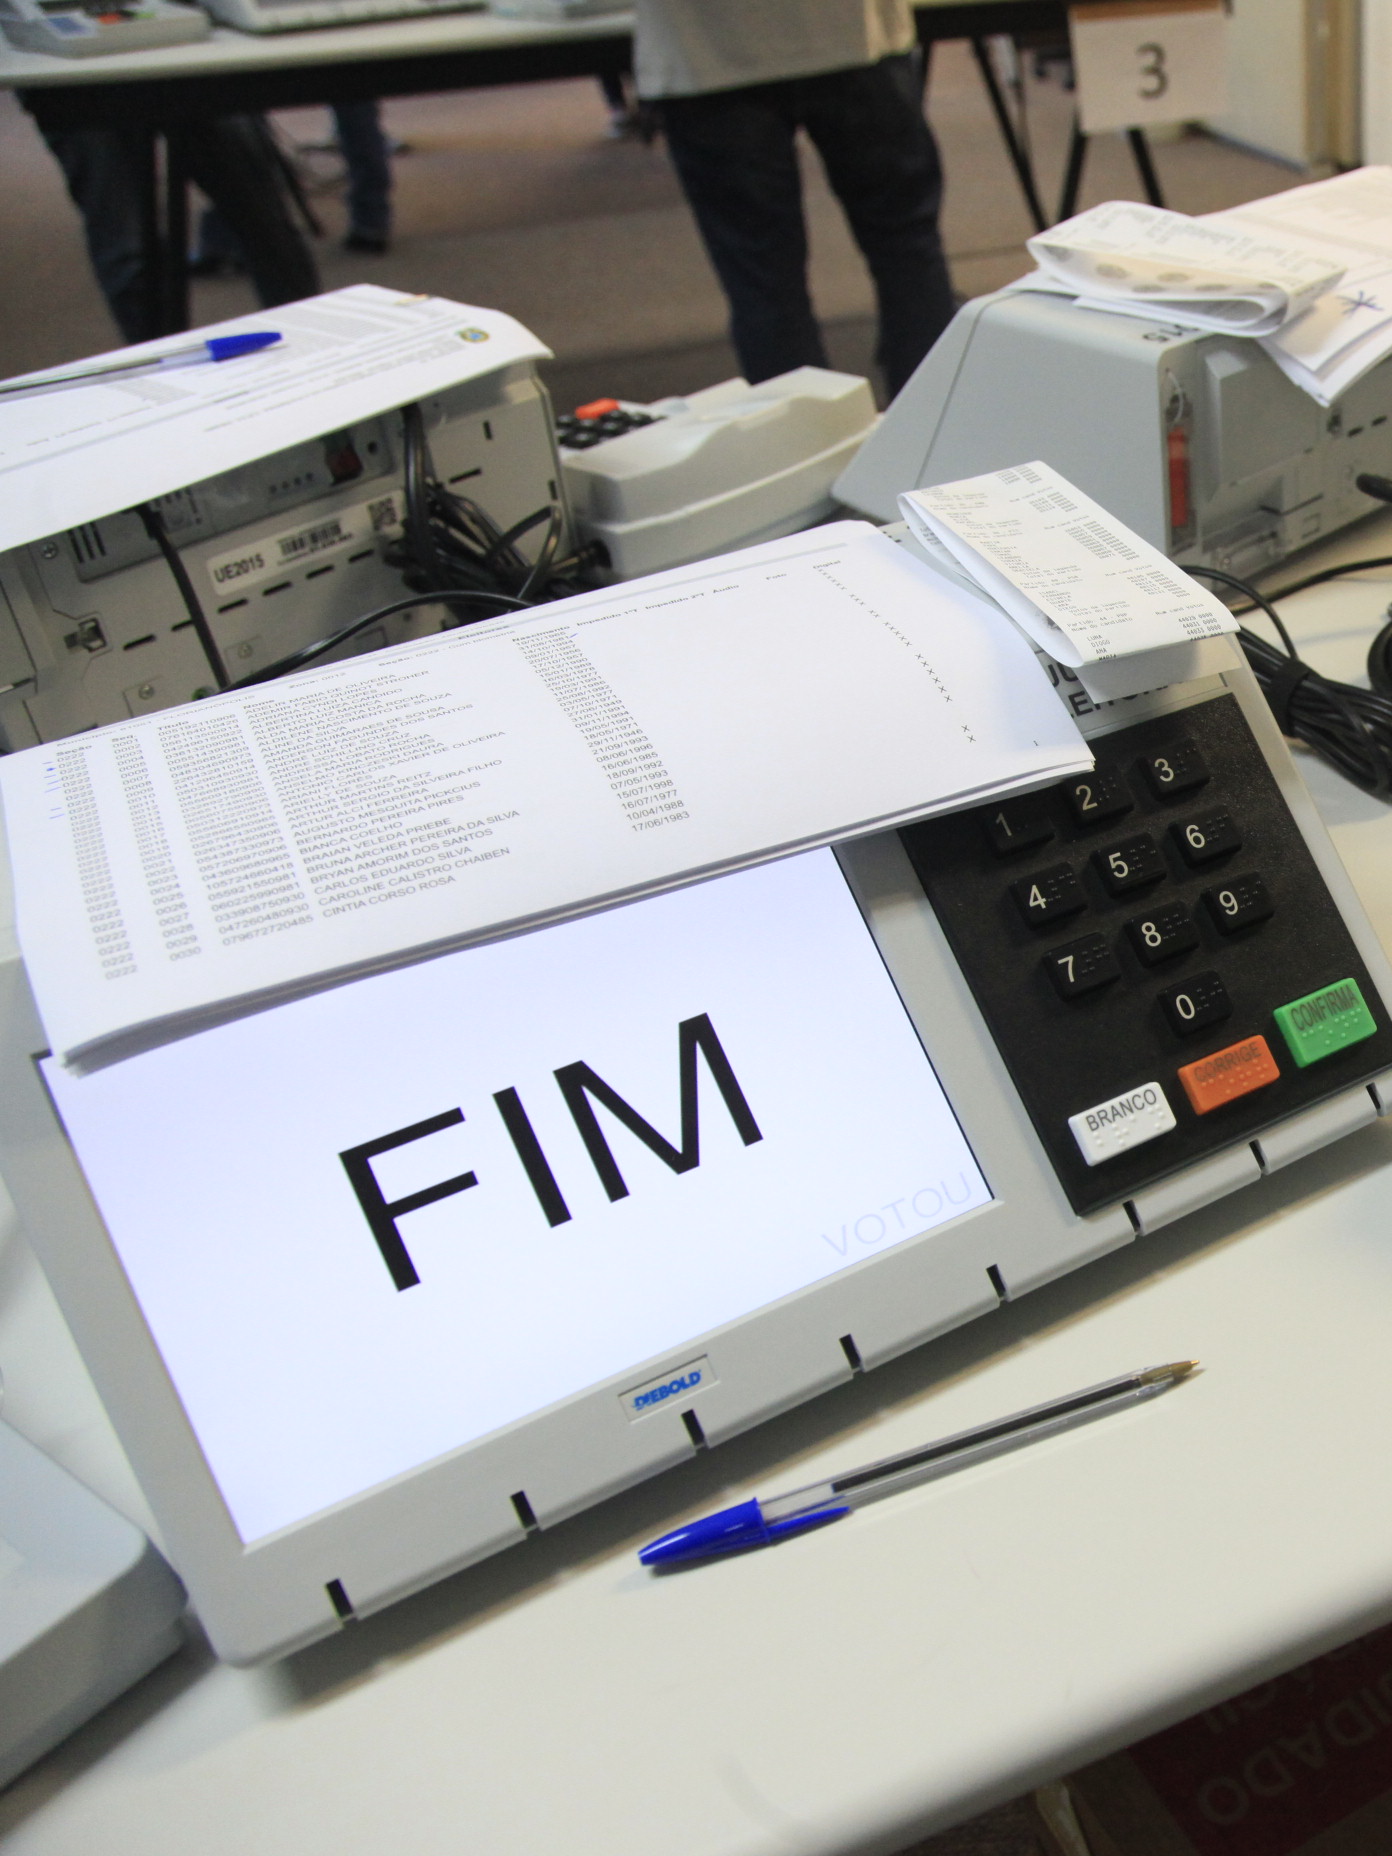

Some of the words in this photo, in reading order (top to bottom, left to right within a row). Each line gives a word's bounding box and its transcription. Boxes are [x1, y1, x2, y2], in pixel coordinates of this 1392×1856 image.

[1136, 43, 1169, 99] 3
[213, 553, 265, 583] UE2015
[89, 909, 121, 923] 0222
[153, 892, 184, 906] 0025
[303, 846, 351, 865] BRAIAN
[353, 831, 404, 851] VELEDA
[406, 817, 453, 836] PRIEBE
[606, 760, 664, 780] 18/09/1992
[296, 821, 368, 846] BERNARDO
[370, 805, 426, 825] PEREIRA
[428, 794, 465, 810] PIRES
[299, 837, 347, 856] BIANCA
[349, 821, 403, 842] COELHO
[995, 811, 1013, 837] 1
[1075, 785, 1098, 811] 2
[1154, 758, 1175, 782] 3
[92, 919, 124, 934] 0222
[156, 901, 188, 916] 0026
[306, 856, 352, 875] BRUNA
[354, 841, 408, 862] ARCHER
[410, 825, 465, 846] PEREIRA
[466, 820, 484, 830] DA
[486, 809, 520, 825] SILVA
[610, 769, 669, 790] 07/05/1993
[95, 930, 127, 945] 0222
[159, 912, 190, 927] 0027
[310, 865, 354, 885] BRYAN
[357, 851, 410, 872] AMORIM
[412, 842, 440, 857] DOS
[442, 828, 494, 849] SANTOS
[616, 779, 674, 800] 15/07/1998
[98, 941, 131, 956] 0222
[162, 923, 194, 938] 0028
[314, 873, 369, 896] CARLOS
[370, 856, 436, 881] EDUARDO
[438, 845, 473, 862] SILVA
[621, 789, 678, 810] 16/07/1977
[101, 952, 134, 968] 0222
[165, 934, 198, 950] 0029
[318, 883, 386, 907] CAROLINE
[388, 863, 452, 888] CALISTRO
[454, 846, 511, 870] CHAIBEN
[626, 799, 685, 821] 10/04/1988
[104, 965, 138, 980] 0222
[169, 946, 202, 962] 0030
[322, 899, 367, 919] CINTIA
[368, 885, 416, 906] CORSO
[419, 874, 456, 892] ROSA
[632, 810, 690, 833] 17/06/1983
[1028, 884, 1047, 910] 4
[1108, 852, 1129, 879] 5
[1185, 824, 1206, 849] 6
[1057, 955, 1076, 983] 7
[1141, 921, 1162, 947] 8
[1219, 890, 1239, 916] 9
[1175, 993, 1196, 1020] 0
[1085, 1088, 1158, 1133] BRANCO
[1192, 1040, 1263, 1082] CORRIGE
[1289, 984, 1361, 1032] CONFIRMA
[338, 1011, 764, 1293] FIM
[820, 1170, 973, 1257] VOTOU
[633, 1369, 702, 1412] DIEBOLD
